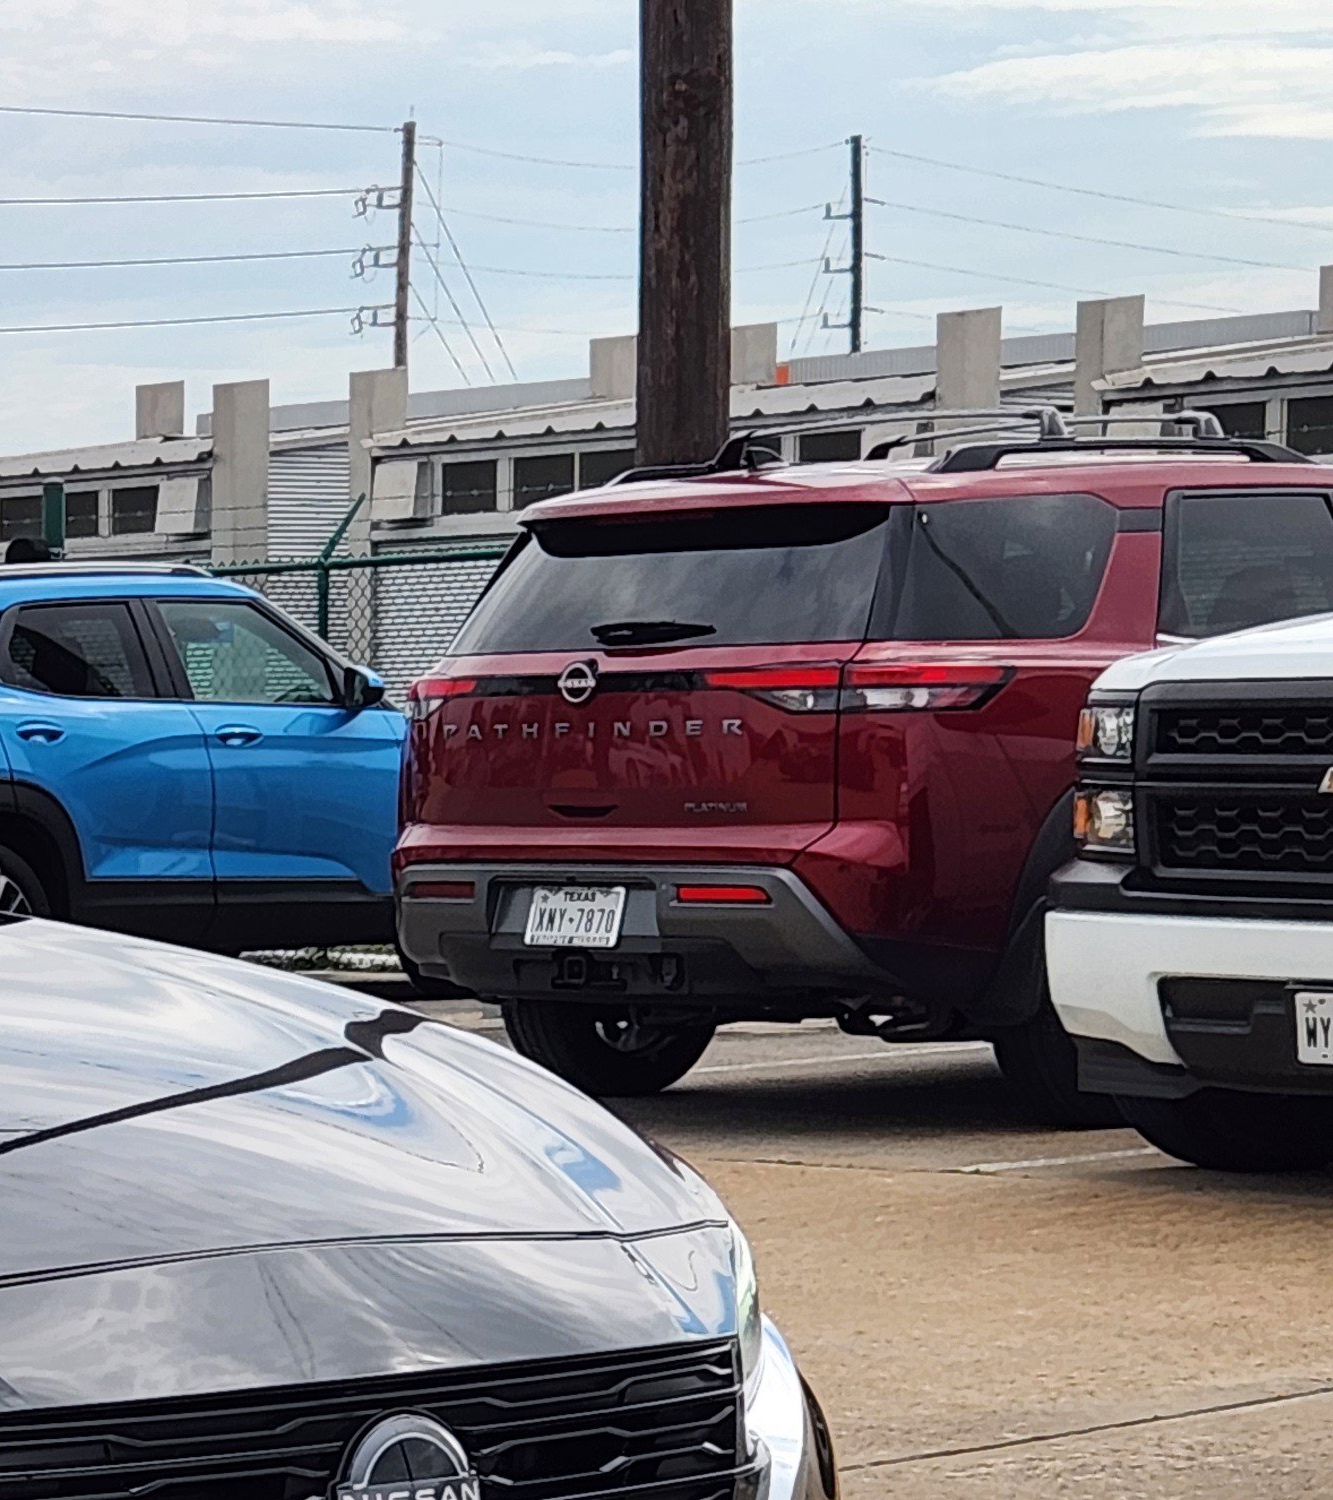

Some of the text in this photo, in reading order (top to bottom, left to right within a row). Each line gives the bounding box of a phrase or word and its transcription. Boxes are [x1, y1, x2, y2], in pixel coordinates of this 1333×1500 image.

[443, 718, 743, 741] PATHFINDER
[684, 802, 748, 813] PLATINUM
[563, 891, 597, 903] TEXAS
